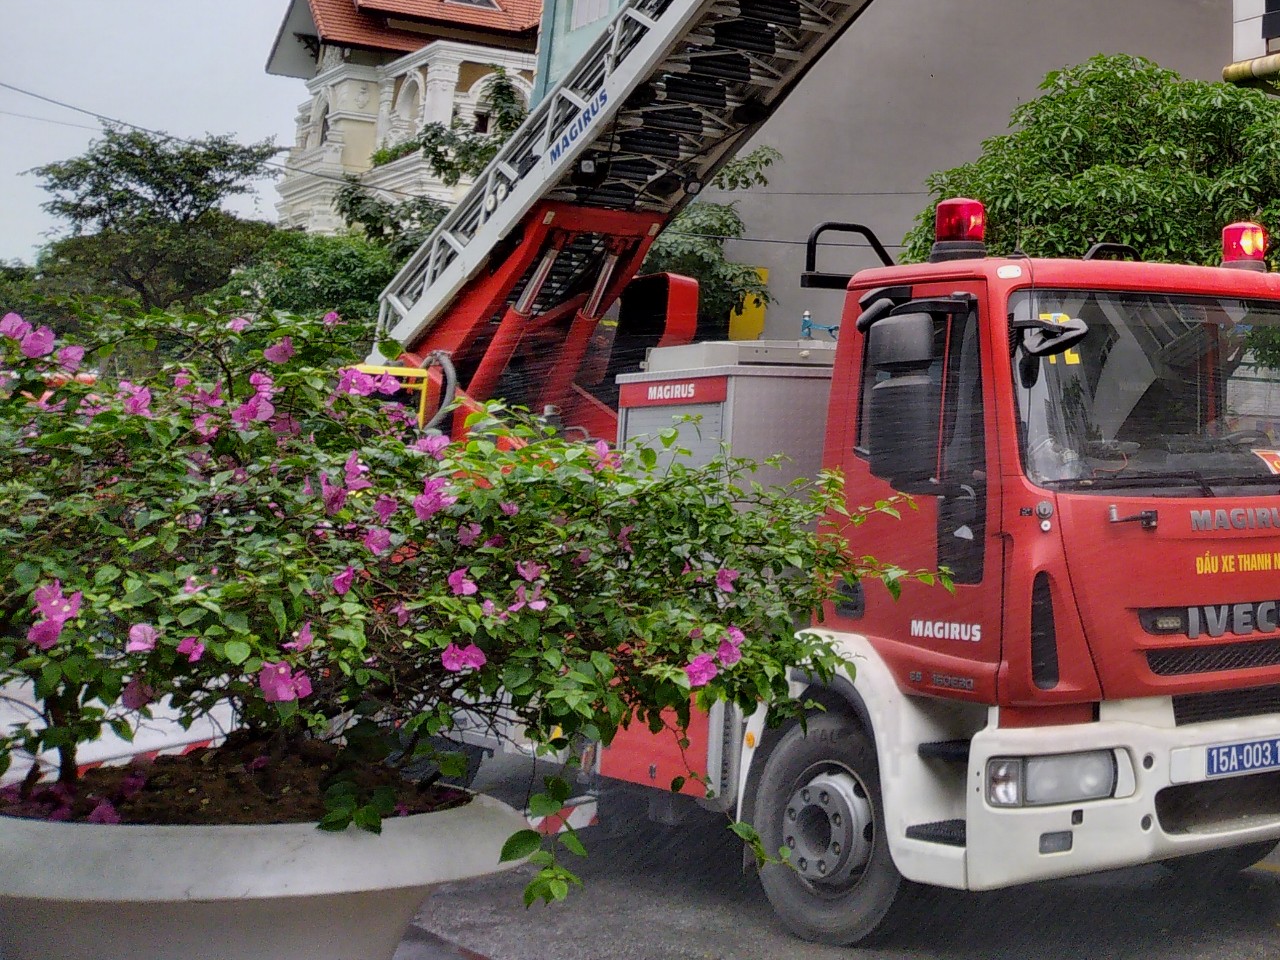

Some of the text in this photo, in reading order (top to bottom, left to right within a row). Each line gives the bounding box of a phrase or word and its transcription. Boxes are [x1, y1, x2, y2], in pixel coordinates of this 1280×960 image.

[549, 88, 608, 165] MAGIRUS
[648, 383, 695, 400] MAGIRUS
[1221, 554, 1236, 572] XE
[1238, 552, 1272, 571] THANH
[911, 620, 981, 642] MAGIRUS
